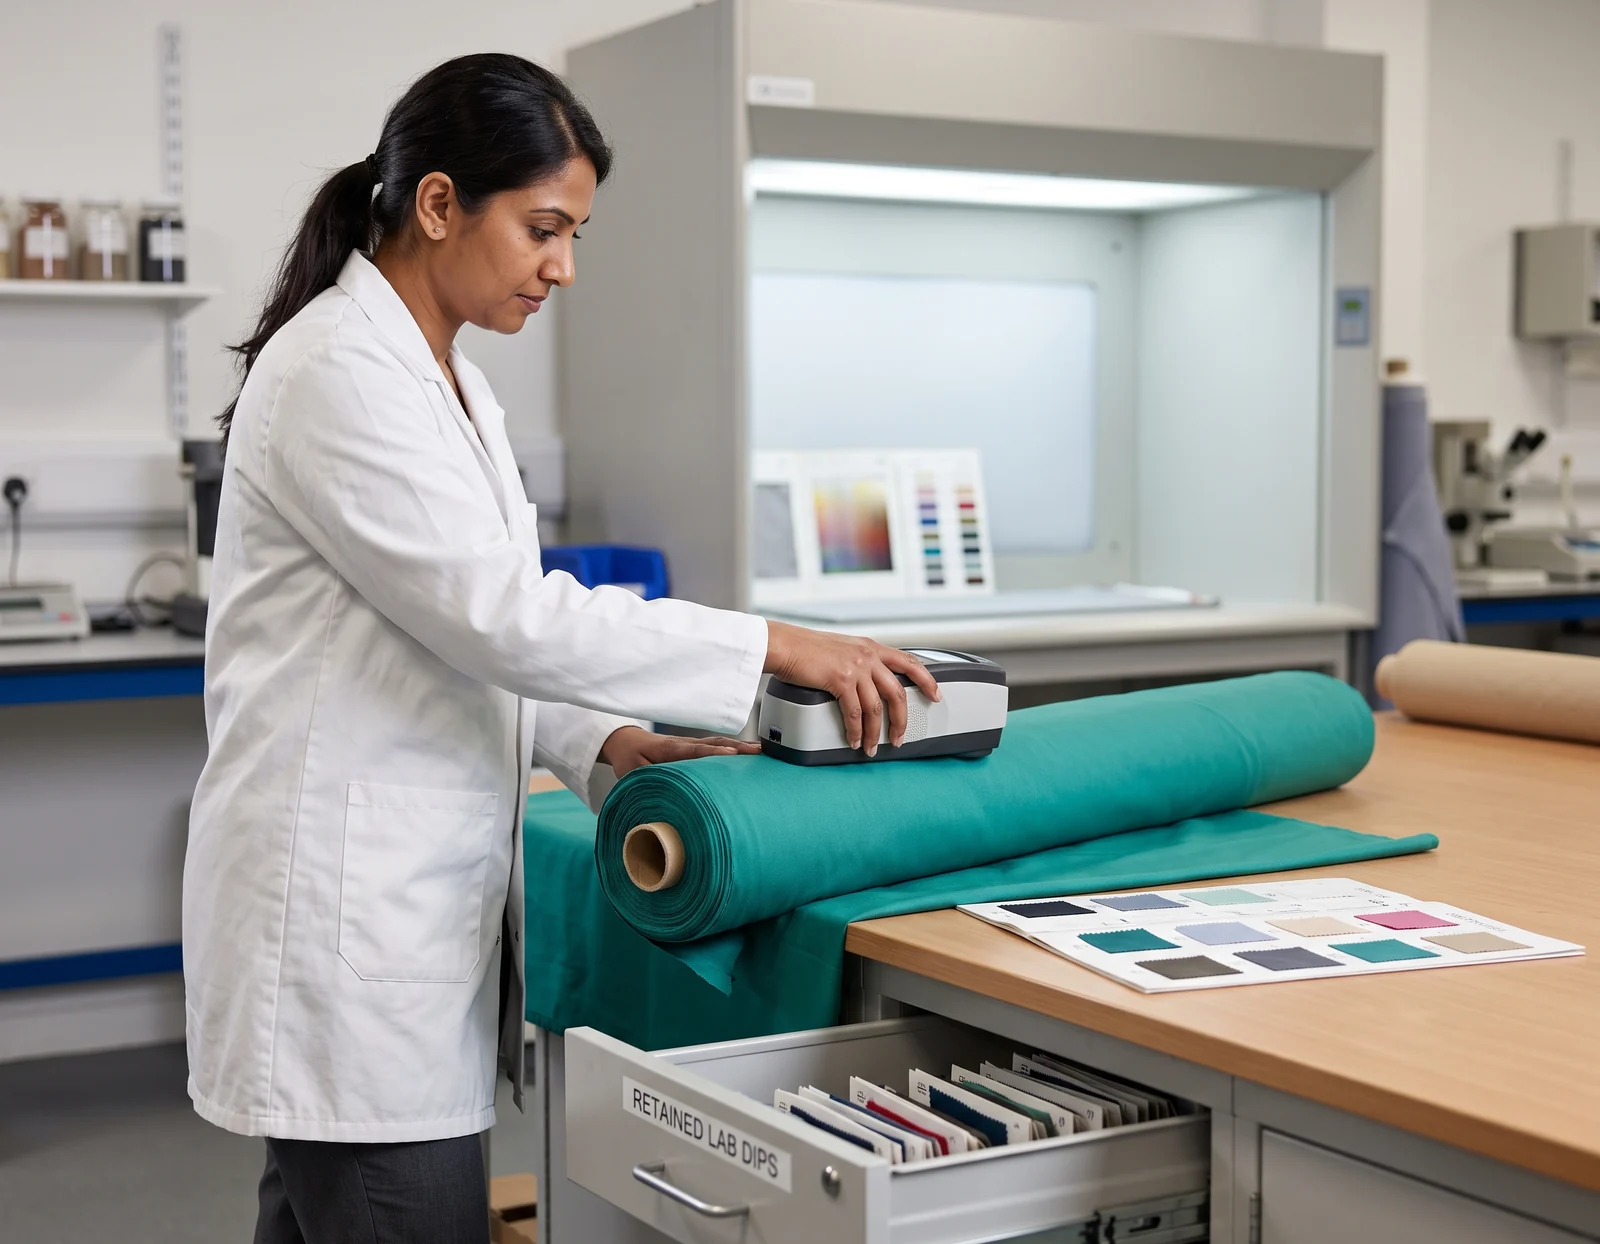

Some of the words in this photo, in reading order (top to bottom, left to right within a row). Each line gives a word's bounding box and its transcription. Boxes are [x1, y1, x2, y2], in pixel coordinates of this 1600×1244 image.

[633, 1088, 704, 1140] RETAINED
[708, 1124, 737, 1157] LAB
[742, 1140, 778, 1178] DIPS
